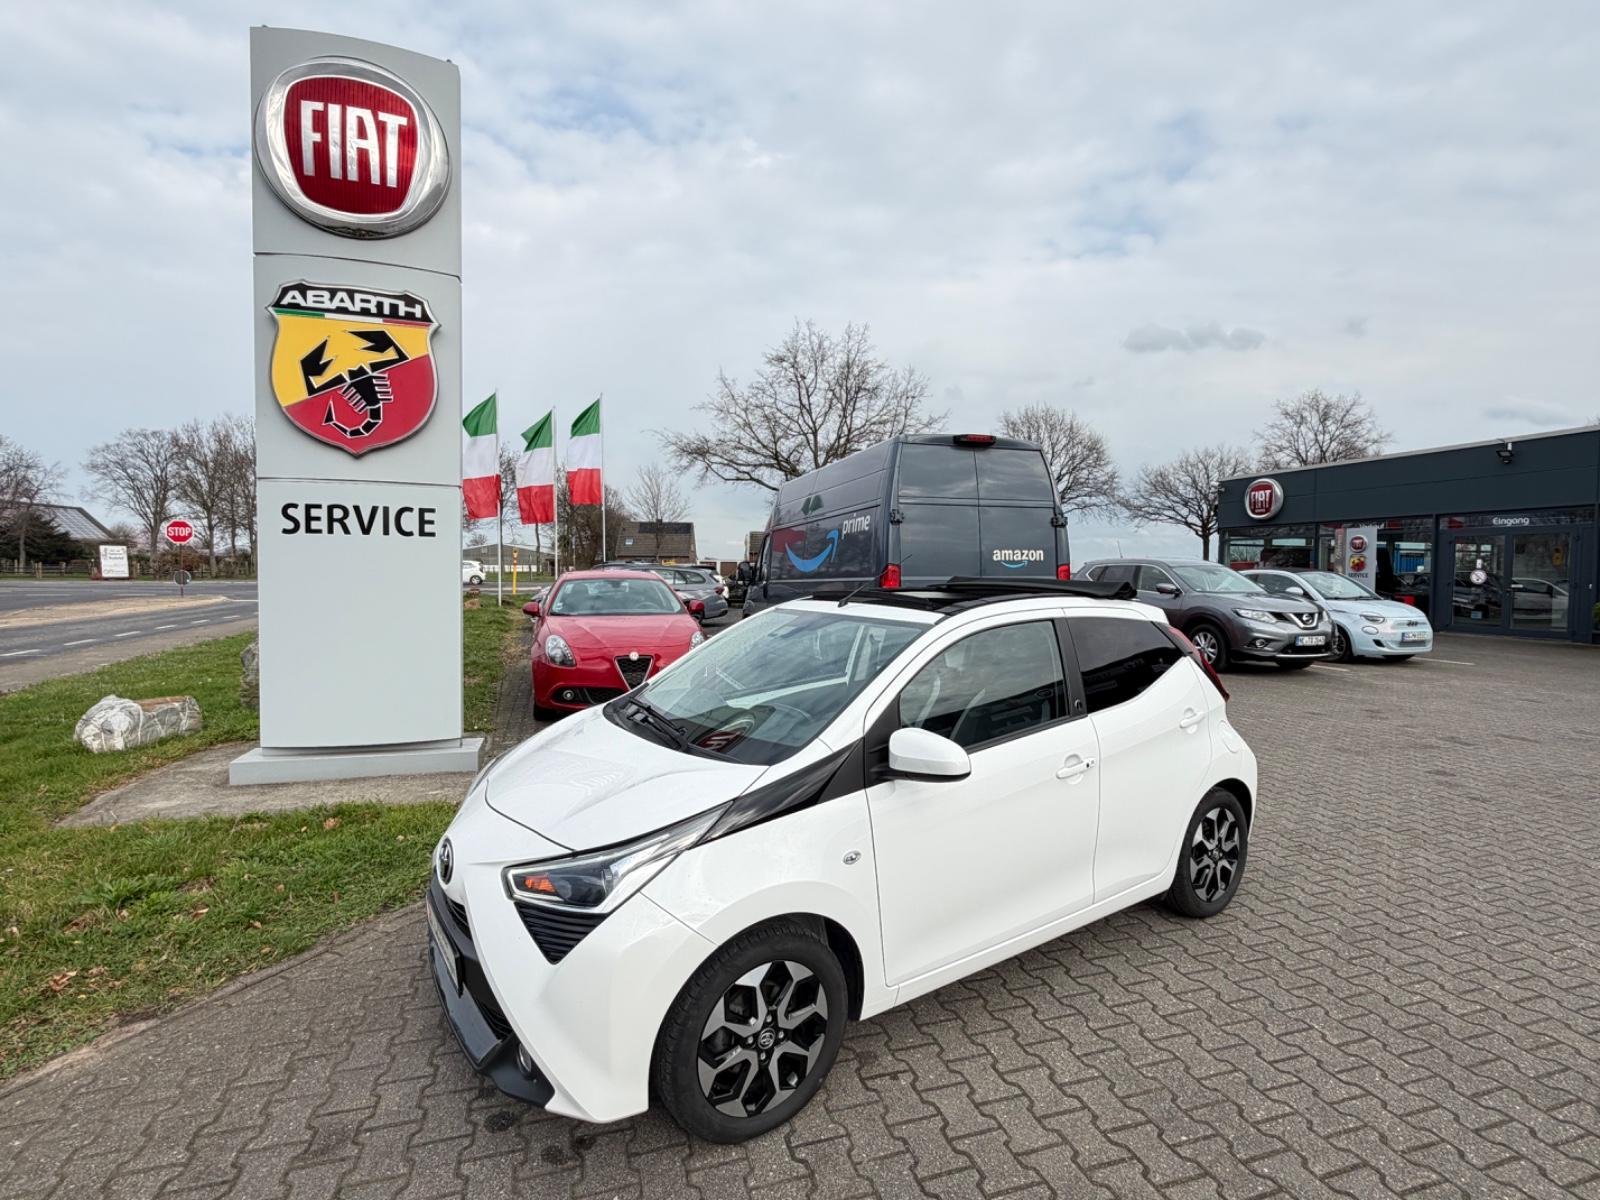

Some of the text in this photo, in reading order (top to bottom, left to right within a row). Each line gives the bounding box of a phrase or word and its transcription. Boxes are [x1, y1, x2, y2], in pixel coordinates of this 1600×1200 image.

[301, 99, 408, 188] FIAT
[280, 290, 422, 319] ABARTH
[1251, 490, 1271, 509] FIAT
[167, 526, 192, 537] STOP
[281, 502, 437, 538] SERVICE
[841, 512, 871, 540] prime
[1492, 517, 1530, 526] Eingang
[992, 549, 1044, 561] amazon
